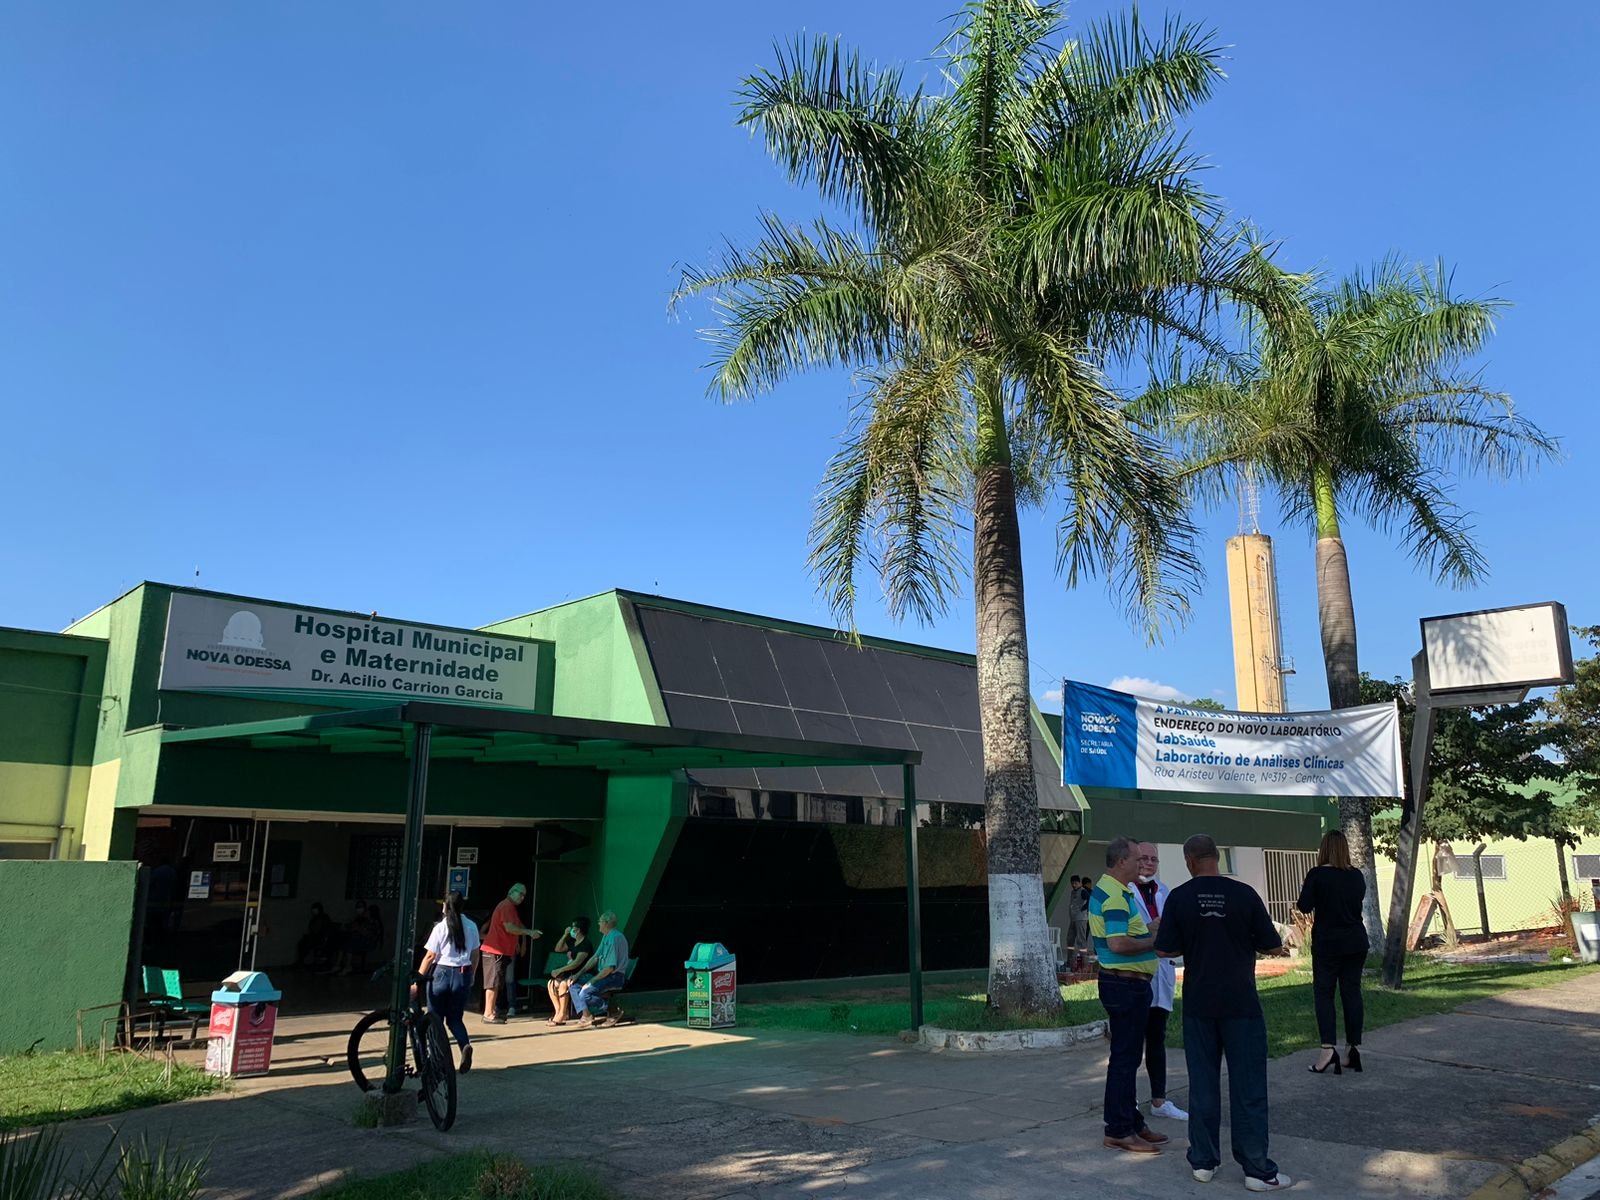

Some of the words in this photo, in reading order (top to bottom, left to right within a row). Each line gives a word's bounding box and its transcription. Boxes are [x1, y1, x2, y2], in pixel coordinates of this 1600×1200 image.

[294, 614, 403, 647] Hospital
[412, 631, 524, 662] Municipal
[186, 648, 231, 665] NOVA
[234, 654, 291, 671] ODESSA
[320, 649, 336, 664] e
[345, 648, 499, 682] Maternidade
[311, 669, 333, 683] Dr.
[339, 672, 386, 688] Acilio
[392, 678, 449, 695] Carrion
[454, 685, 503, 700] Garcia
[1080, 714, 1107, 724] NOVA
[1155, 705, 1164, 714] A
[1081, 723, 1116, 734] ODESSA
[1154, 717, 1215, 734] ENDEREÇO
[1217, 722, 1234, 734] DO
[1236, 723, 1268, 736] NOVO
[1270, 723, 1342, 737] LABORATÓRIO
[1080, 739, 1113, 748] SECRETARIA
[1156, 732, 1216, 748] LabSaúde
[1156, 749, 1231, 766] Laboratório
[1235, 753, 1250, 767] de
[1253, 754, 1300, 769] Análises
[1304, 754, 1344, 769] Clínicas
[1154, 766, 1174, 778] Rua
[1177, 767, 1214, 780] Aristeu
[1217, 769, 1257, 784] Valente,
[1295, 773, 1325, 784] Centro
